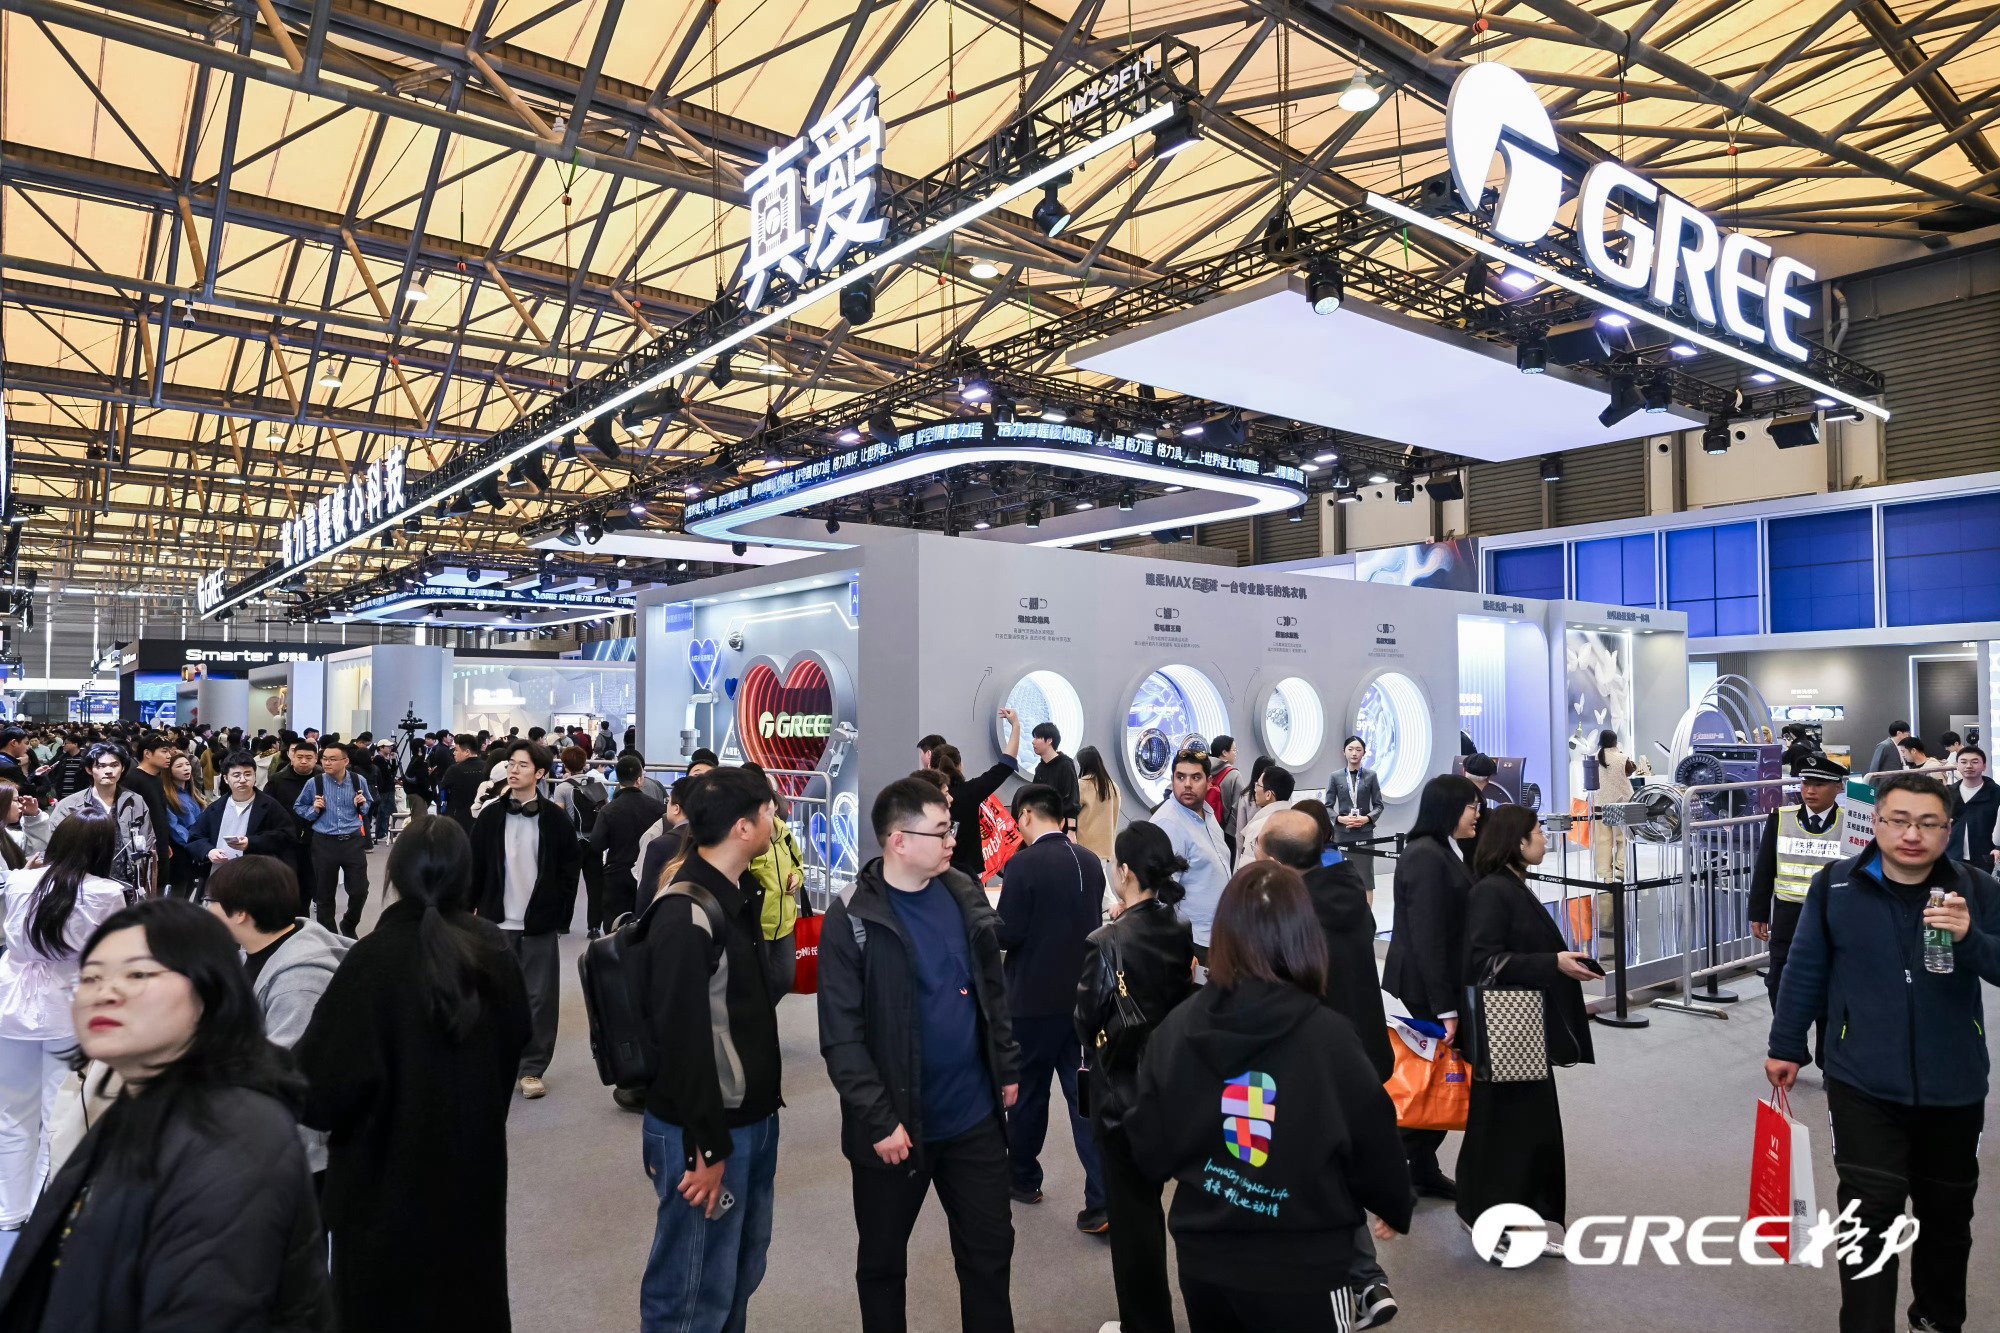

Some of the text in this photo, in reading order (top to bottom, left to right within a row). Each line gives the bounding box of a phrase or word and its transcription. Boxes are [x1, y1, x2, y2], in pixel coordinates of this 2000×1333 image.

[743, 75, 889, 311] 真爱
[1577, 160, 1818, 363] GREE
[1157, 442, 1183, 461] 格力真
[185, 649, 273, 662] Smarter
[777, 714, 832, 739] GREE
[1545, 876, 1564, 885] GREE
[1271, 1188, 1290, 1200] Life
